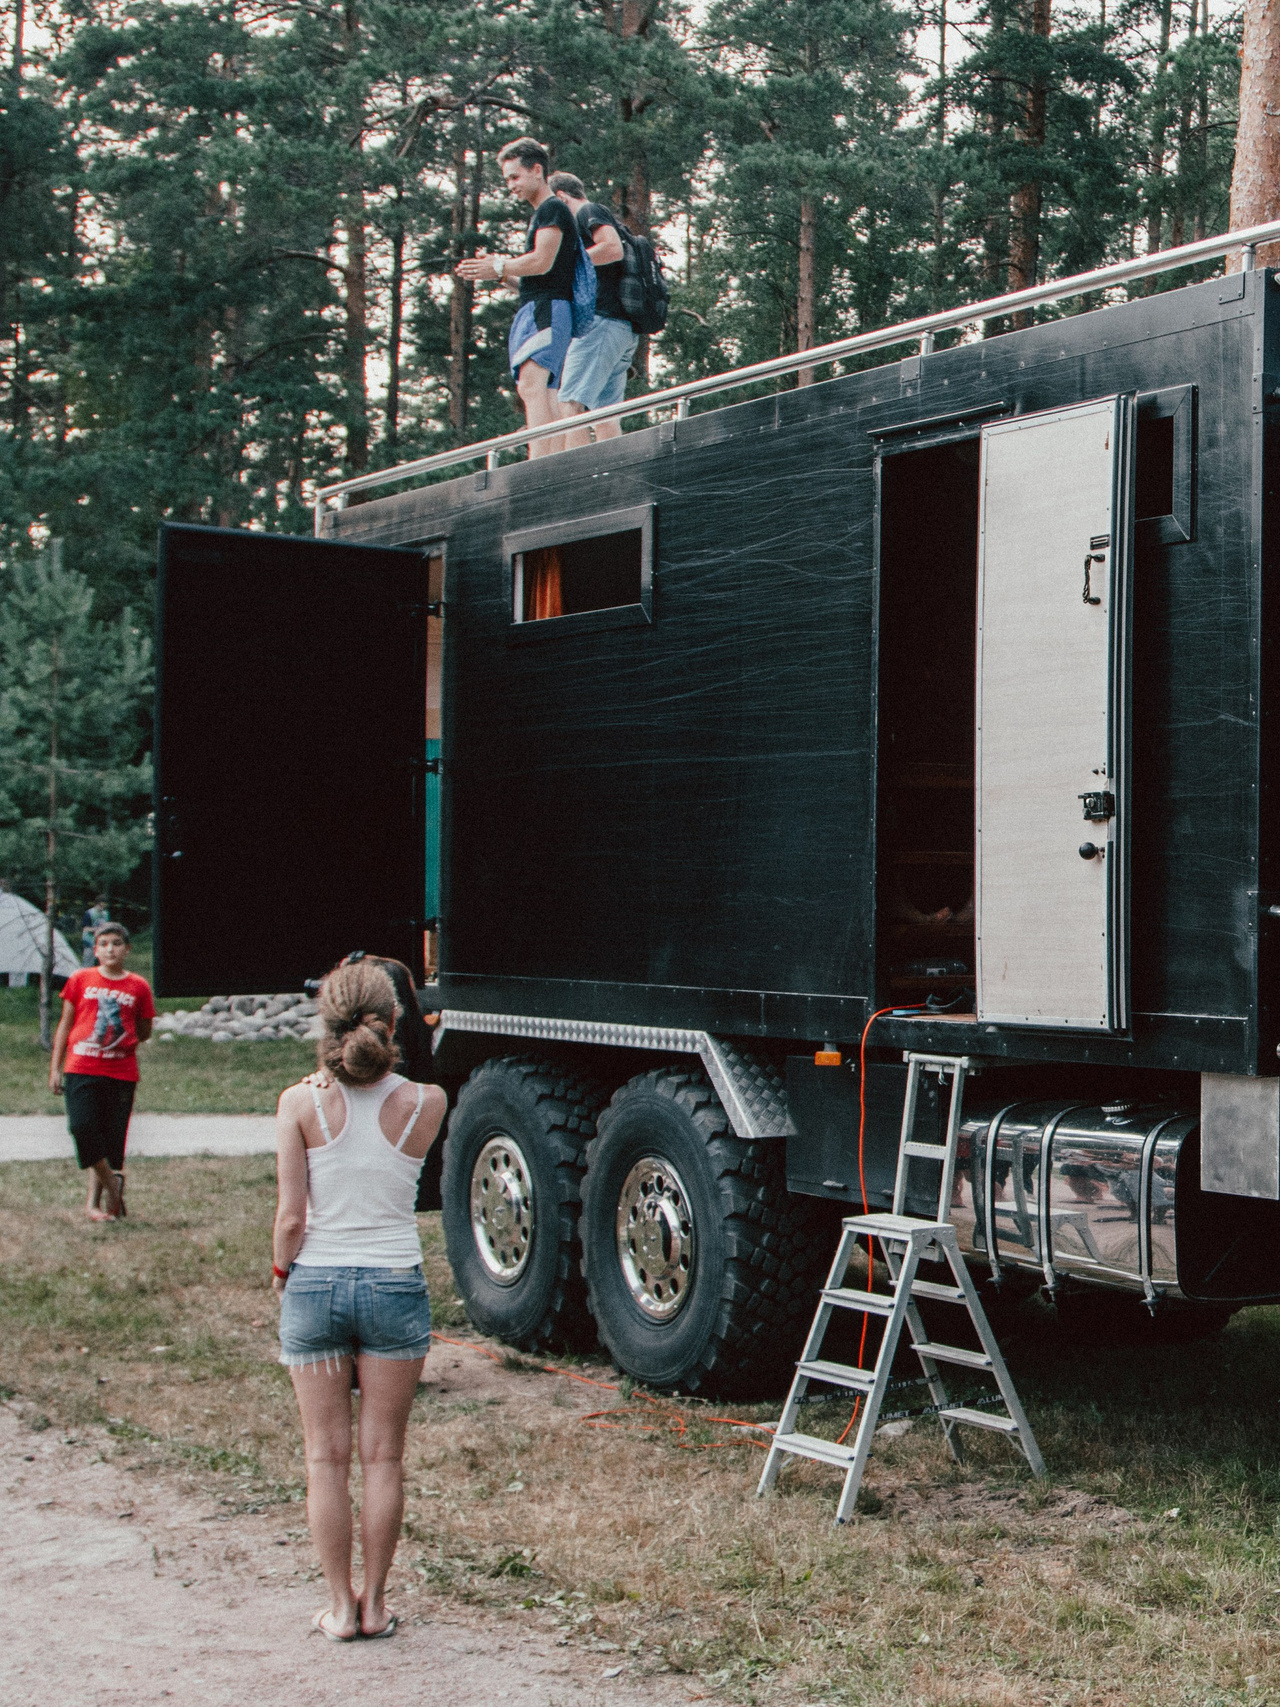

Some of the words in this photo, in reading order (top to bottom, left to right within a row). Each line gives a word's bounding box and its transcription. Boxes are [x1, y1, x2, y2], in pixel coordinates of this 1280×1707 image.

[881, 1410, 910, 1420] UMET
[922, 1402, 965, 1414] ALUMET
[976, 1394, 1004, 1405] ALUM
